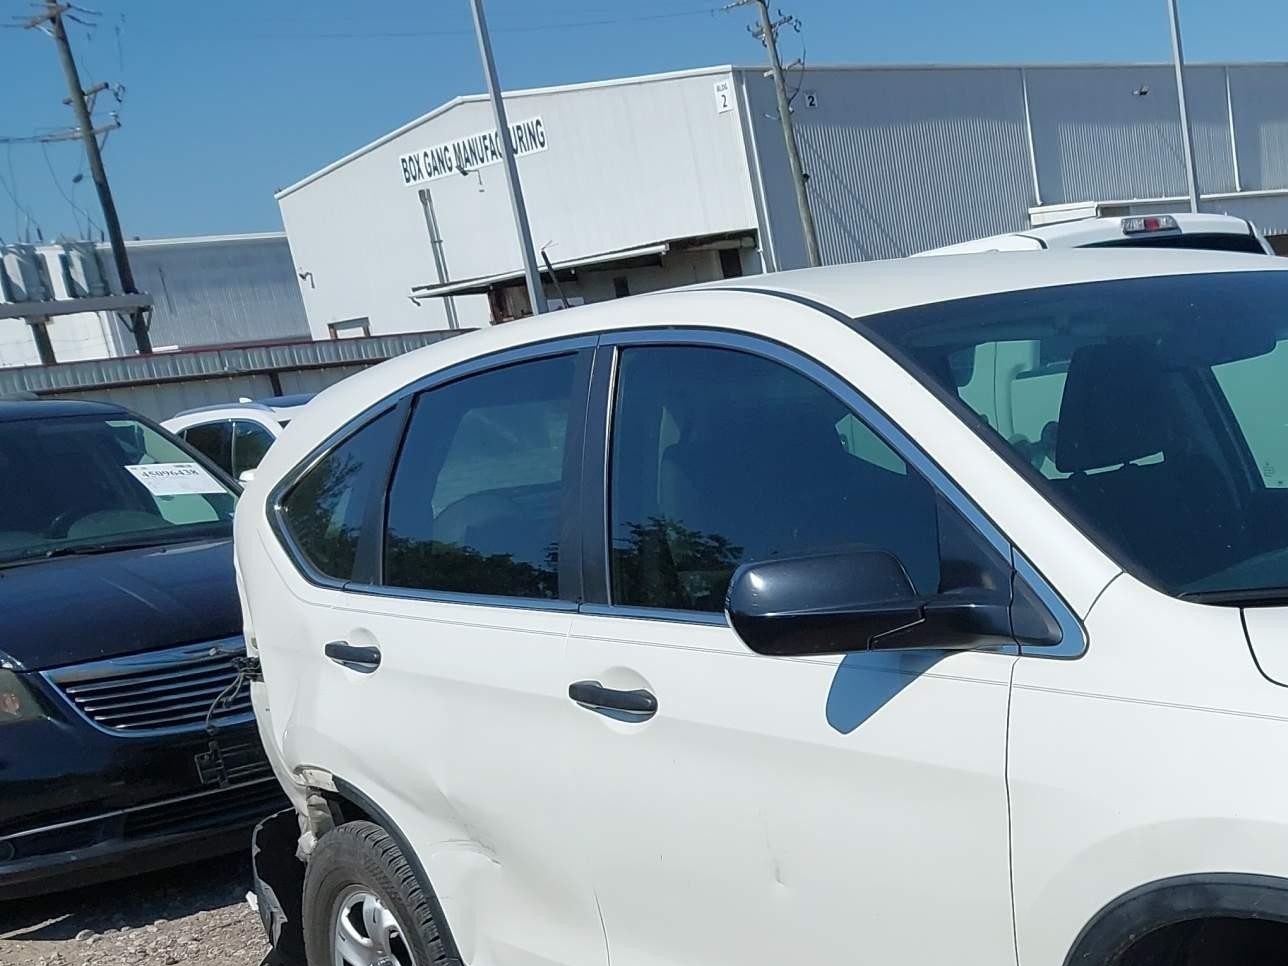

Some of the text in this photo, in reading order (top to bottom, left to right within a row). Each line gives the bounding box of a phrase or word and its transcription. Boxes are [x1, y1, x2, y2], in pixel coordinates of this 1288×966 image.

[721, 94, 728, 108] 2
[807, 95, 816, 107] 2
[401, 119, 546, 183] BOX GANG MANUFACURING
